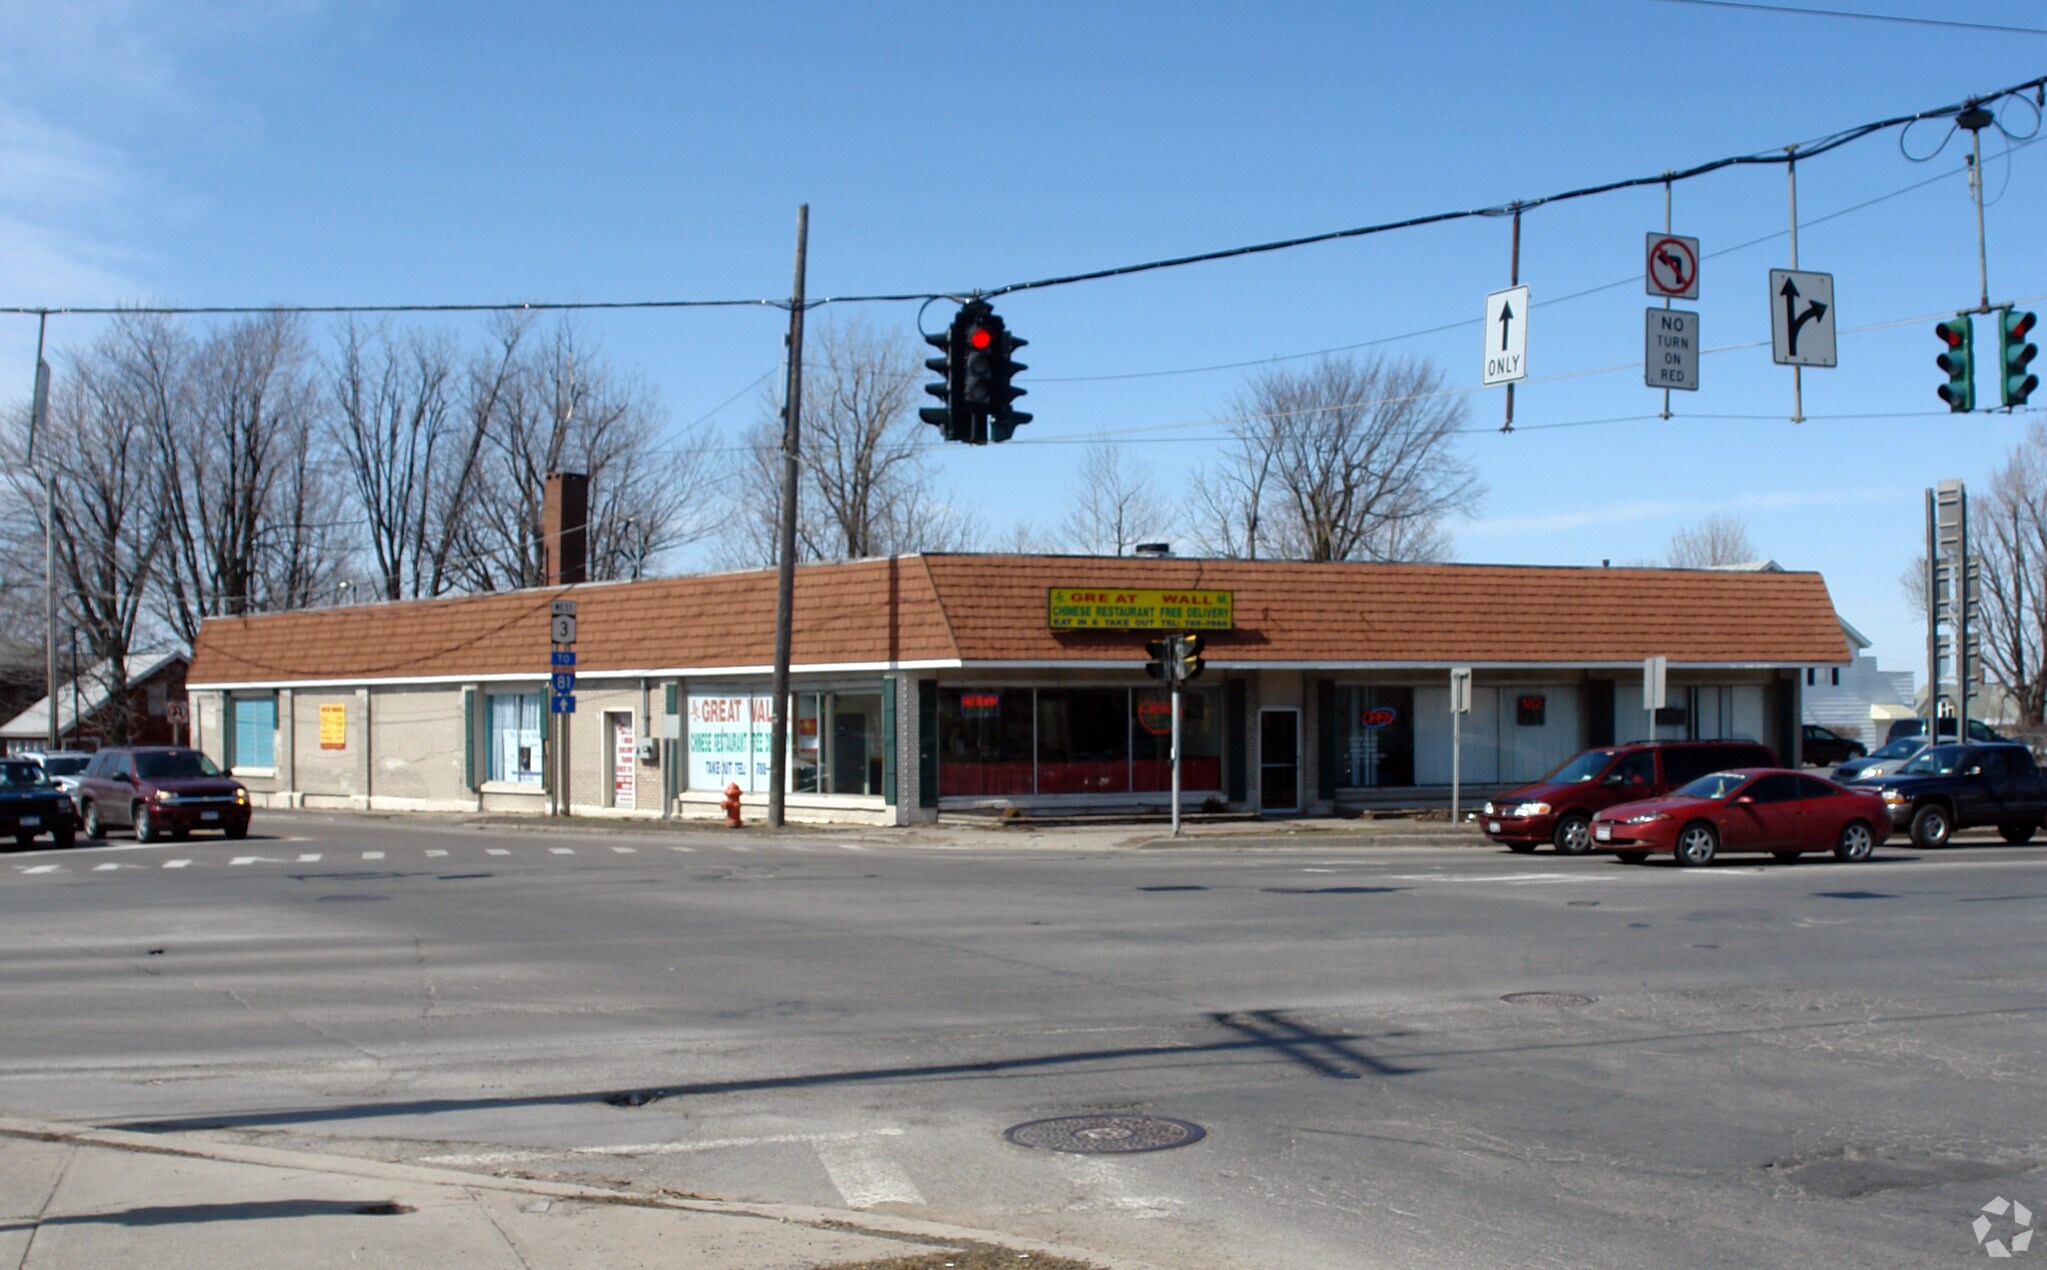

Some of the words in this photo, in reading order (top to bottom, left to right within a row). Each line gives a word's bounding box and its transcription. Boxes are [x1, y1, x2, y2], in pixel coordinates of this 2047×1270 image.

[1661, 315, 1684, 332] NO
[1657, 334, 1689, 349] TURN
[1488, 354, 1520, 377] ONLY
[1664, 352, 1681, 365] ON
[1660, 368, 1685, 383] RED
[1070, 593, 1138, 604] GREAT
[1162, 594, 1212, 605] WALL
[1053, 606, 1091, 618] CHINESE
[1096, 606, 1155, 618] RESTAURANT
[1160, 607, 1182, 618] FREE
[1187, 608, 1229, 618] DELIVERY
[559, 621, 568, 637] 3
[557, 653, 570, 661] TO
[557, 675, 571, 689] 81
[702, 699, 742, 722] GREAT
[1362, 710, 1393, 726] OPEN
[706, 761, 720, 775] TAKE
